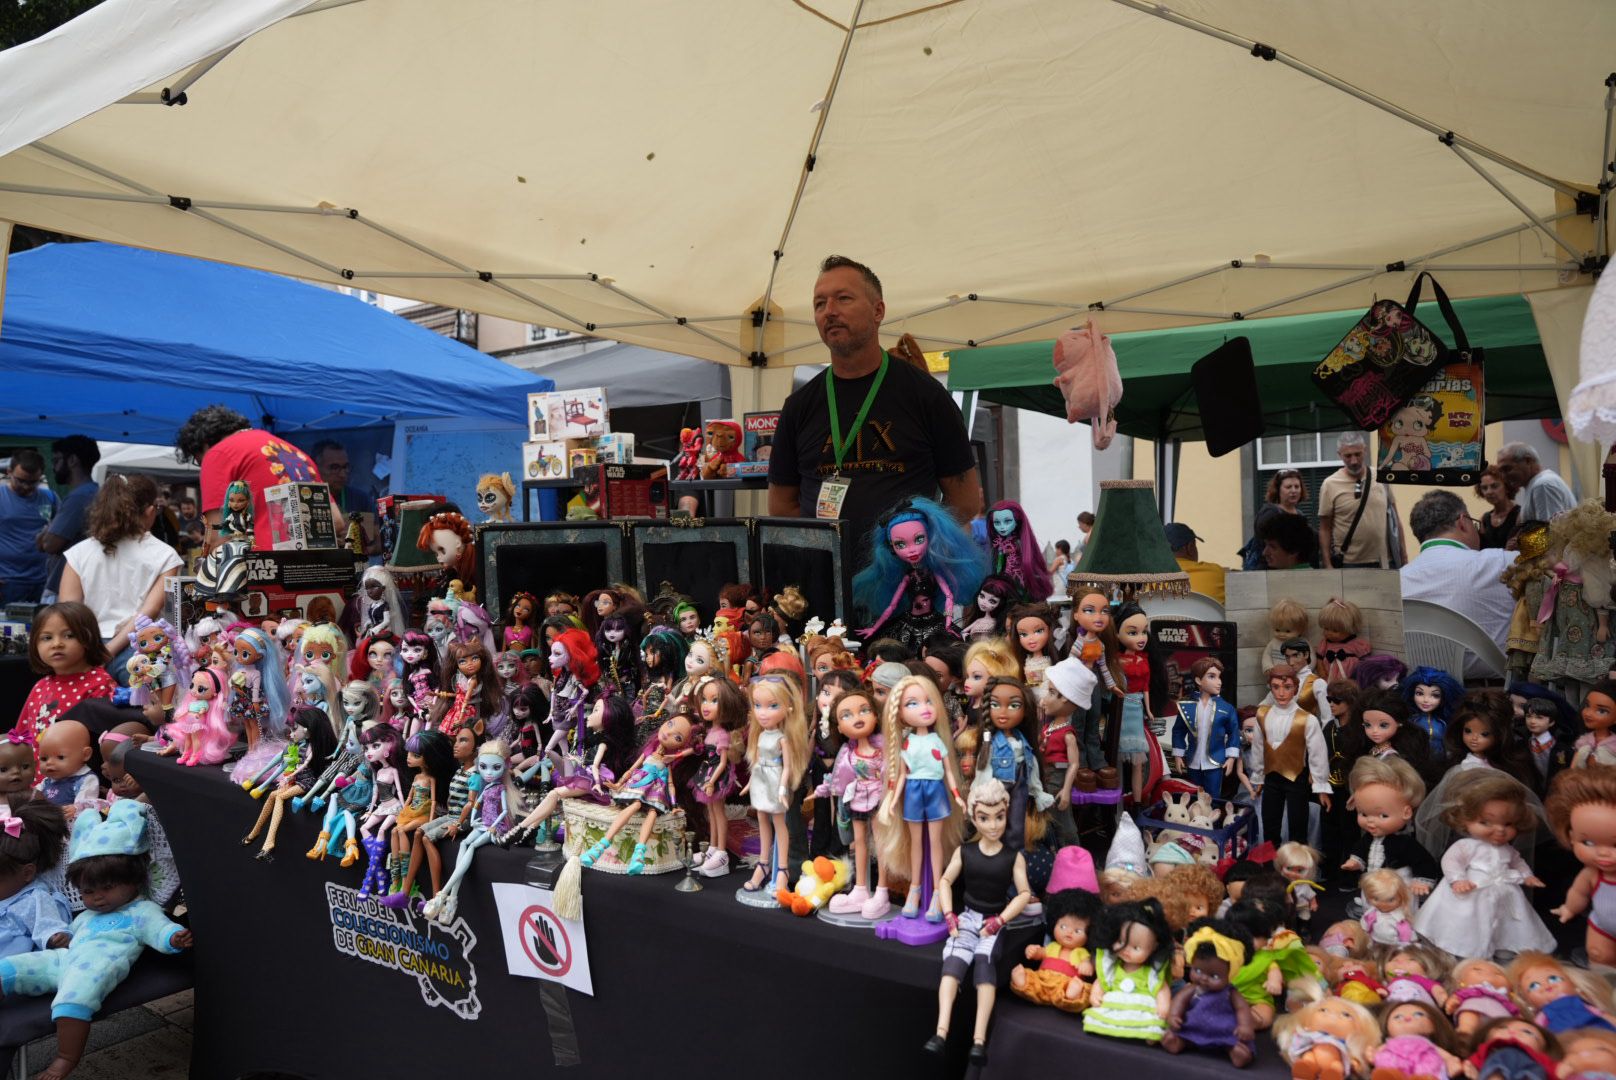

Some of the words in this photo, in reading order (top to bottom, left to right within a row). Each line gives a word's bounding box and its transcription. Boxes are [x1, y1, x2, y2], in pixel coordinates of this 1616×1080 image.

[747, 416, 779, 430] MONO
[246, 559, 278, 570] TAR
[247, 569, 278, 581] ARS
[1158, 628, 1188, 636] STAR
[1158, 634, 1188, 643] WARS
[328, 887, 366, 914] FERIA
[367, 899, 394, 922] DEL
[332, 908, 450, 961] COLECCIONISMO
[336, 928, 354, 951] DE
[355, 934, 397, 966] GRAN
[399, 949, 466, 989] CANARIA
